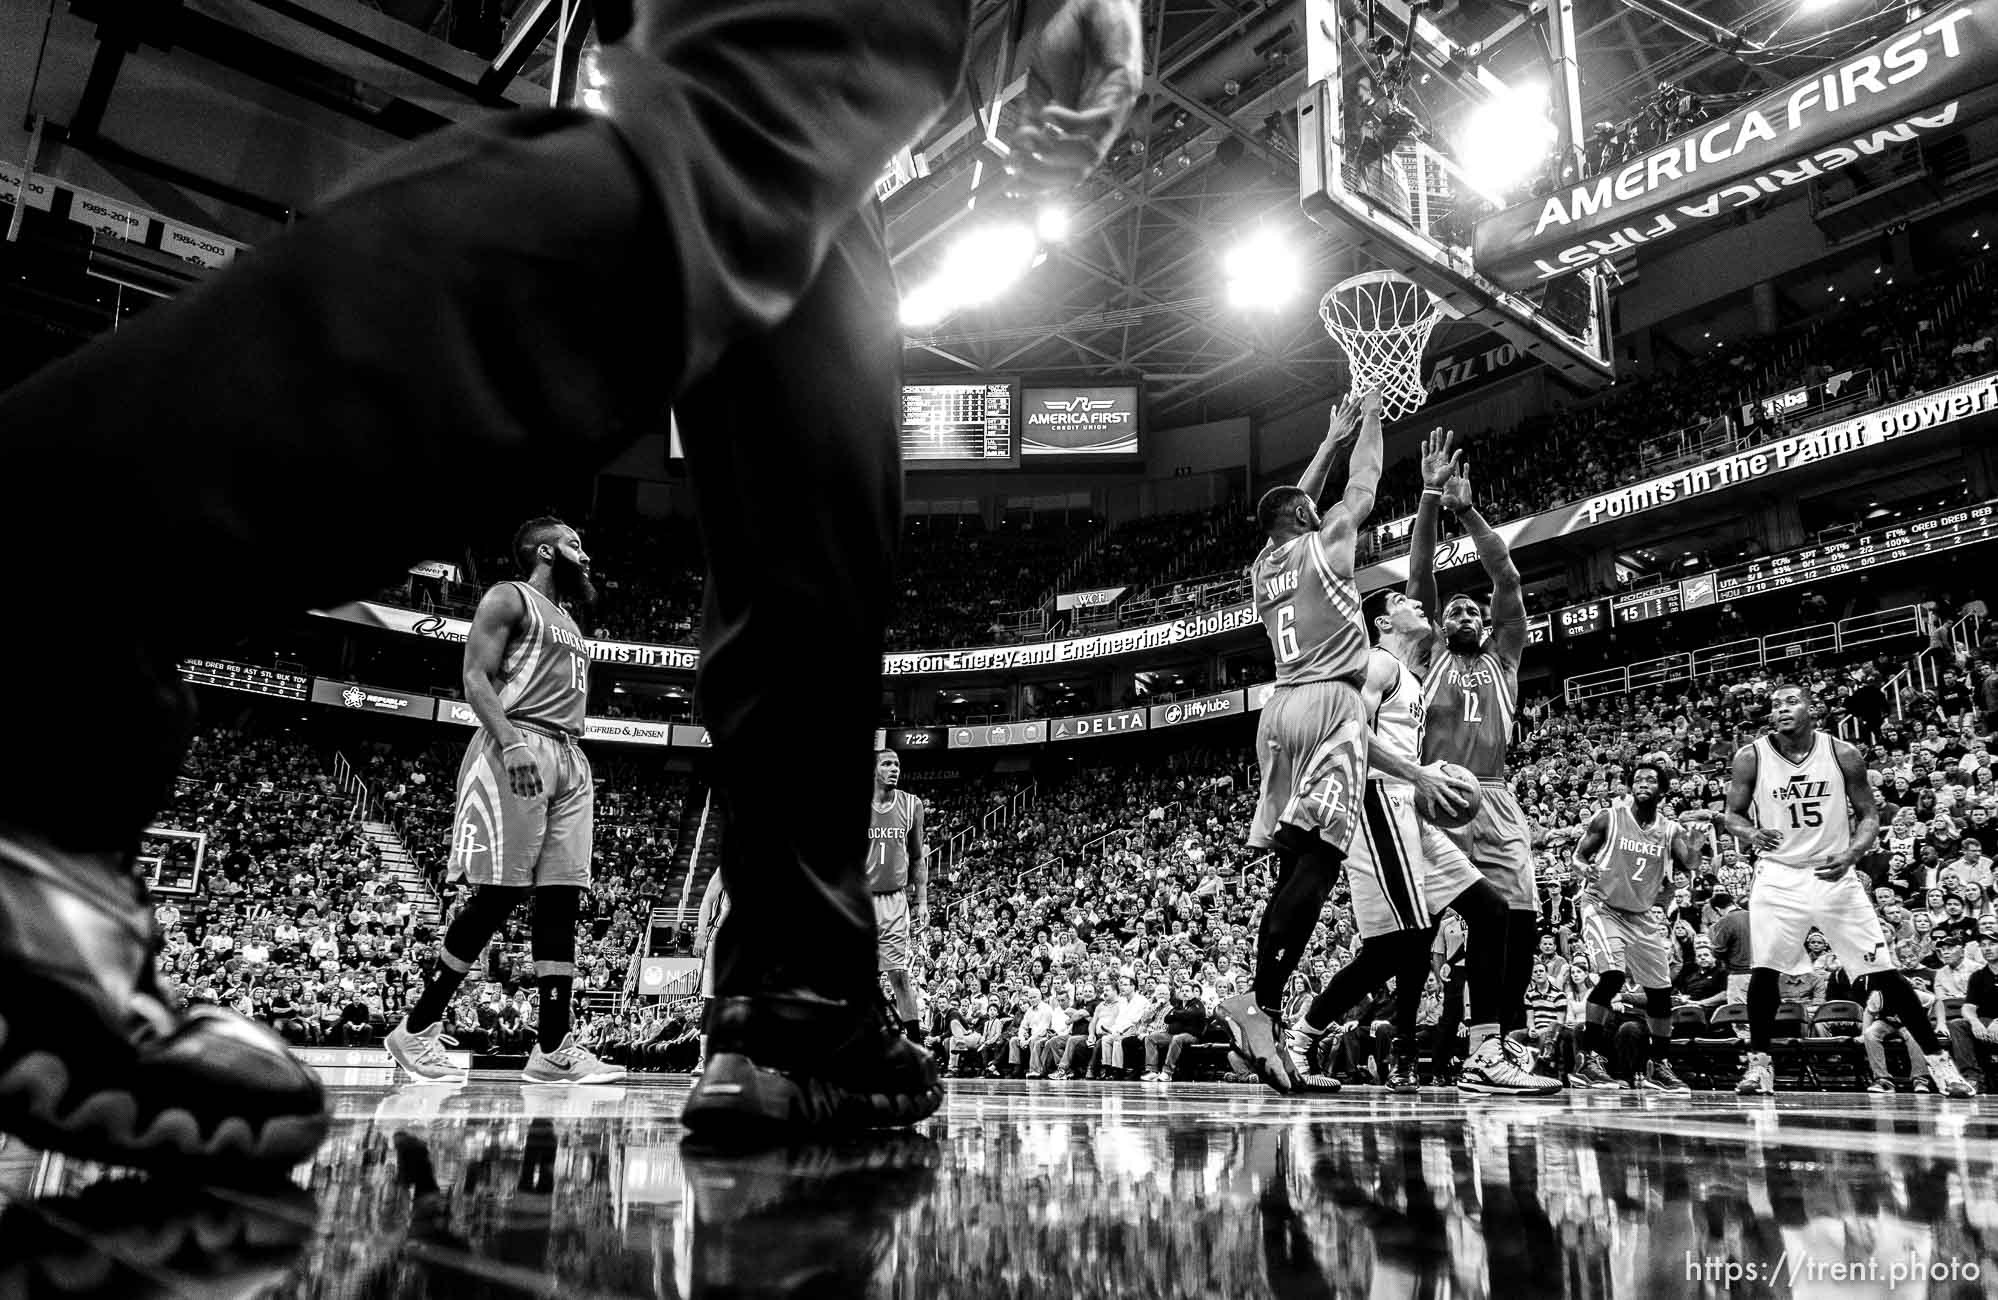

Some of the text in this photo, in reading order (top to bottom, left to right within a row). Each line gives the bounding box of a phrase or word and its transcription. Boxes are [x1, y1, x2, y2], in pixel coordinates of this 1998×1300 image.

[1534, 110, 1776, 236] AMERICA
[1786, 8, 1974, 131] FIRST
[1534, 102, 1959, 279] AMERICA FIRST
[81, 201, 139, 227] 1985-2009
[172, 231, 225, 256] 1984-2003
[1028, 411, 1131, 425] AMERICA FIRST
[1588, 482, 1676, 524] Points
[1683, 470, 1711, 496] in
[1718, 453, 1768, 485] the
[1775, 422, 1865, 468] Paint
[1860, 536, 1871, 546] FT
[1885, 528, 1906, 539] FT%
[1911, 520, 1938, 533] OREB
[1940, 512, 1968, 526] DREB
[1971, 507, 1992, 518] REB
[1720, 578, 1738, 589] UTA
[1885, 537, 1911, 548] 100%
[1265, 569, 1299, 601] JONES
[1562, 604, 1599, 626] 6:35
[1621, 606, 1639, 621] 15
[1277, 605, 1300, 663] 6
[1527, 629, 1543, 644] 12
[1569, 625, 1584, 635] QTR
[635, 648, 655, 665] in
[661, 650, 695, 668] the
[949, 651, 1019, 671] Energy
[1021, 642, 1056, 665] and
[1060, 629, 1171, 662] Engineering
[243, 667, 258, 676] AST
[570, 651, 585, 693] 13
[450, 705, 481, 724] Key
[1183, 698, 1230, 721] jiffylube
[1462, 689, 1482, 722] 12
[622, 726, 632, 736] &
[632, 727, 665, 738] JENSEN
[1077, 713, 1143, 737] DELTA
[905, 734, 929, 745] 7:22
[1772, 775, 1832, 800] JAZZ
[1788, 802, 1824, 829] 15
[879, 842, 886, 864] 1
[1619, 836, 1665, 857] ROCKET
[1631, 857, 1647, 881] 2
